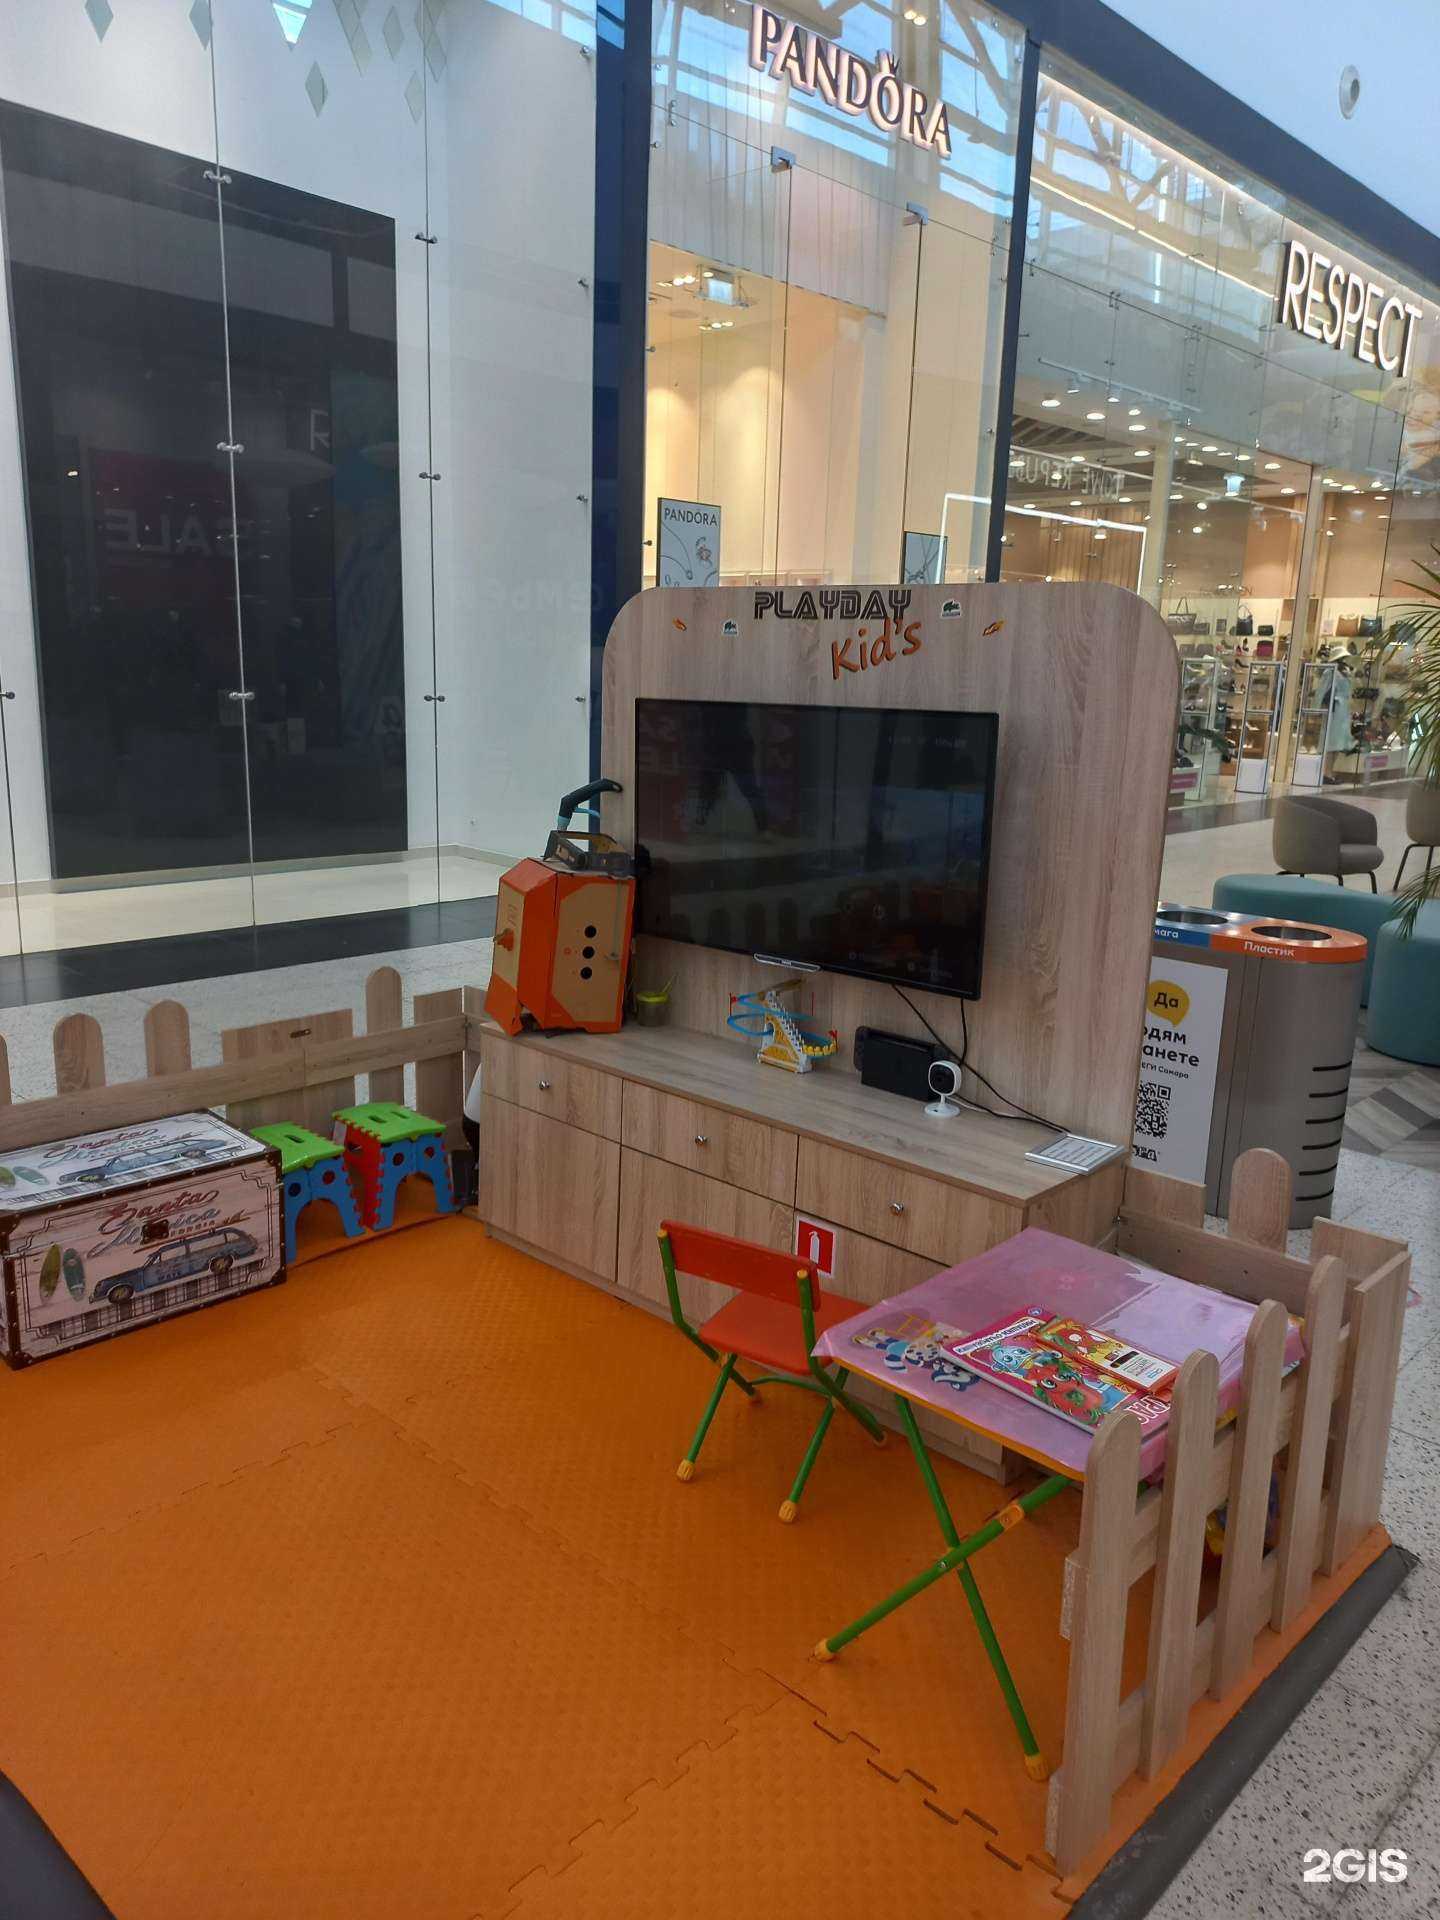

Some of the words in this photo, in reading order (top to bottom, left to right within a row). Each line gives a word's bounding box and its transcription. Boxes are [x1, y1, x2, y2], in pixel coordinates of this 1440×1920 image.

[750, 4, 952, 160] PANDORA
[1279, 239, 1424, 378] RESPECT
[664, 507, 718, 526] PANDORA
[753, 589, 912, 620] PLAYDAY
[831, 617, 922, 680] Kid's
[1154, 928, 1179, 939] мага
[1244, 941, 1296, 957] Пластик
[1154, 992, 1179, 1009] Да
[1144, 1026, 1187, 1044] дям
[1142, 1045, 1200, 1067] анете
